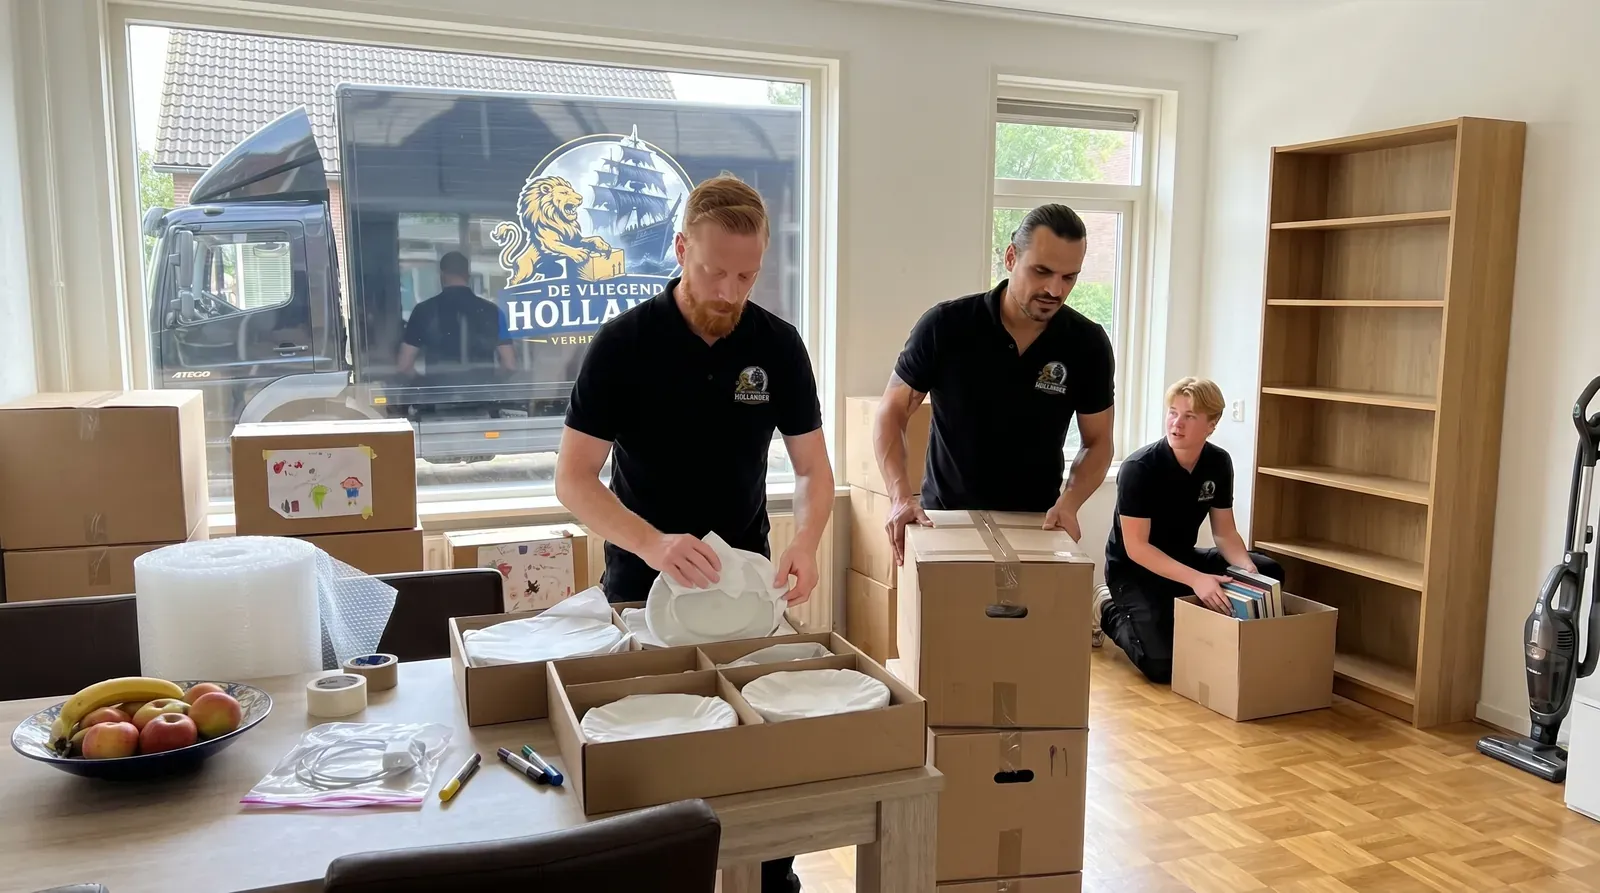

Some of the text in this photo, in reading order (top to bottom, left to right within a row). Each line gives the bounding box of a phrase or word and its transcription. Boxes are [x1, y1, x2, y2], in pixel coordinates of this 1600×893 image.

[548, 284, 664, 297] DE VLIEGEND
[171, 370, 211, 379] ATEGO
[734, 393, 770, 401] HOLLANDER
